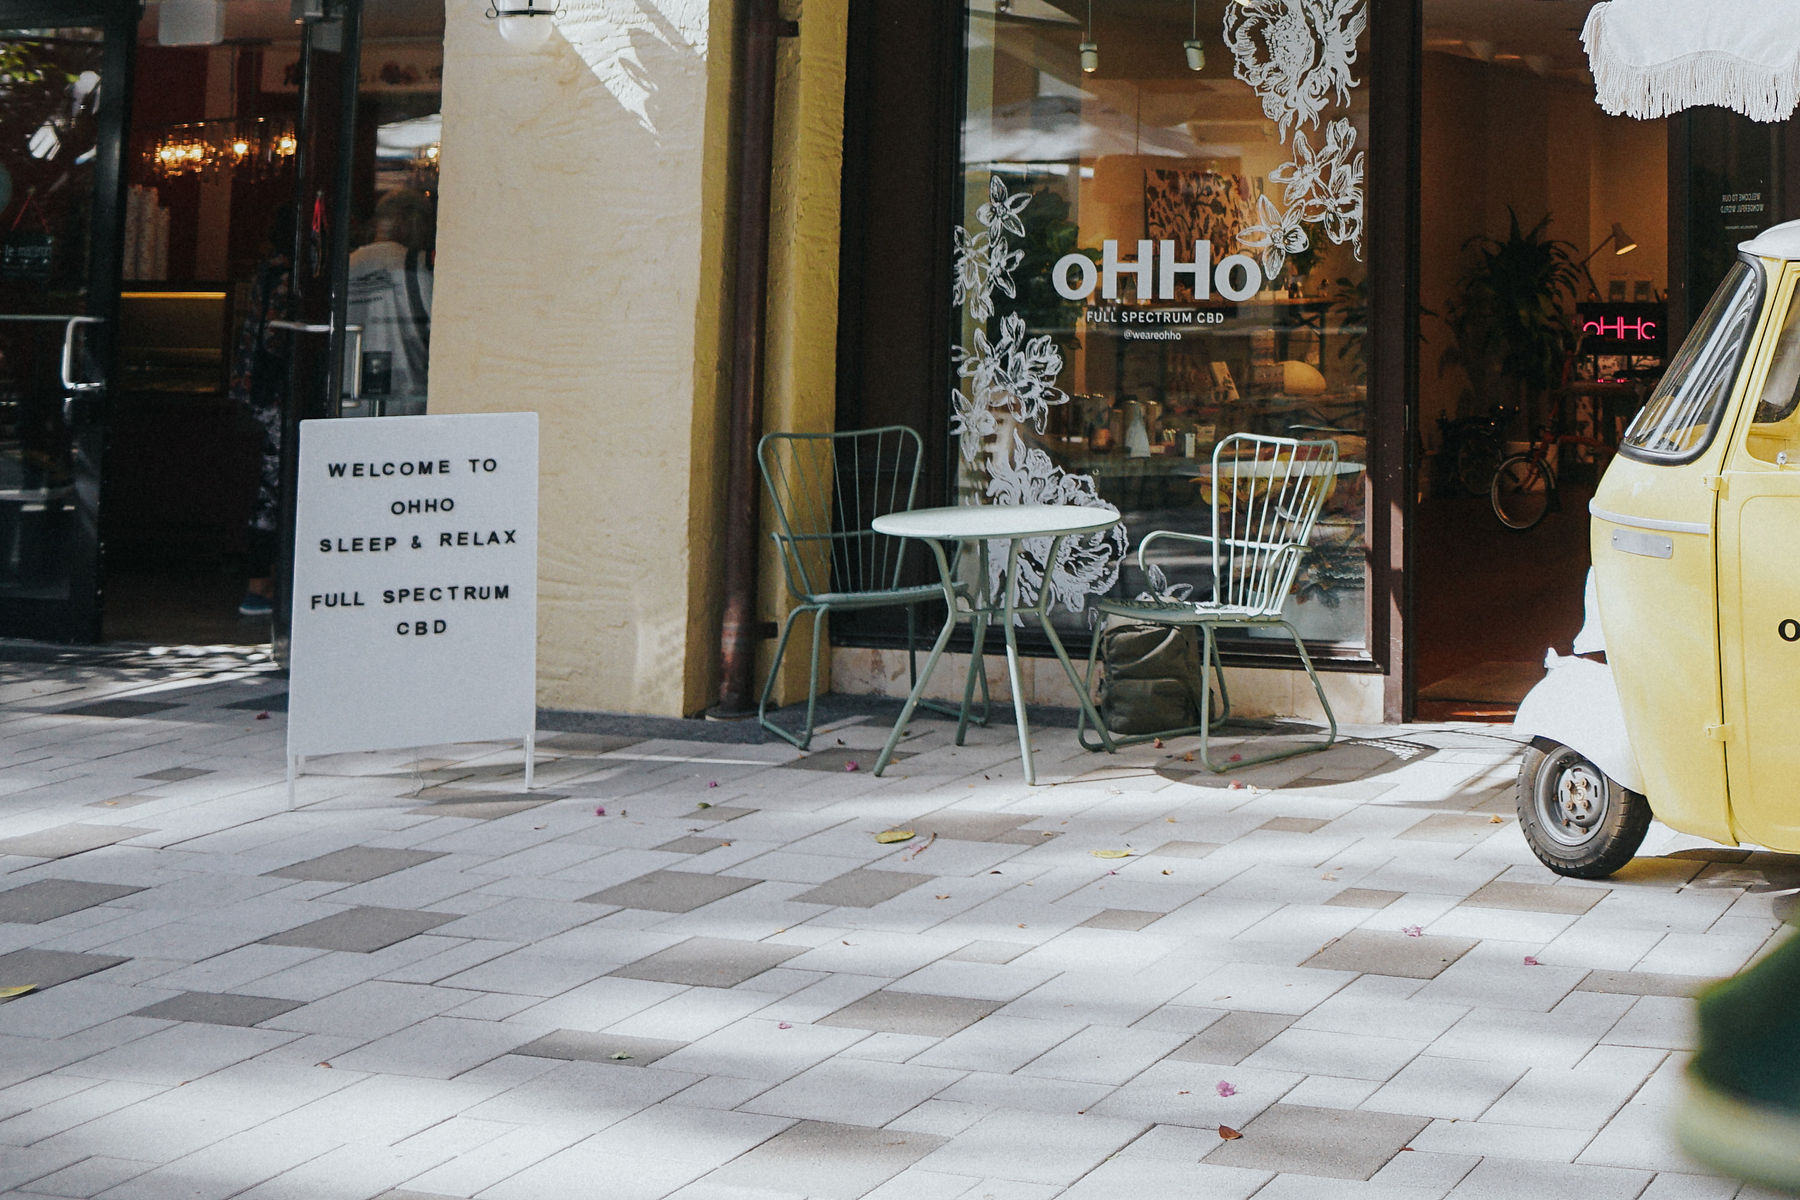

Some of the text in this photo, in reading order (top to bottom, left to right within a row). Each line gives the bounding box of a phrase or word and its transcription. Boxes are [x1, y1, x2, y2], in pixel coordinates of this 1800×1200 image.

[1052, 239, 1262, 302] oHHo
[1086, 311, 1225, 324] FULL SPECTRUM CBD
[1123, 329, 1182, 340] @weareohho
[328, 458, 497, 477] WELCOME TO
[391, 498, 455, 515] OHHO
[319, 529, 517, 553] SLEEP & RELAX
[311, 584, 510, 610] FULL SPECTRUM
[396, 620, 447, 635] CBD
